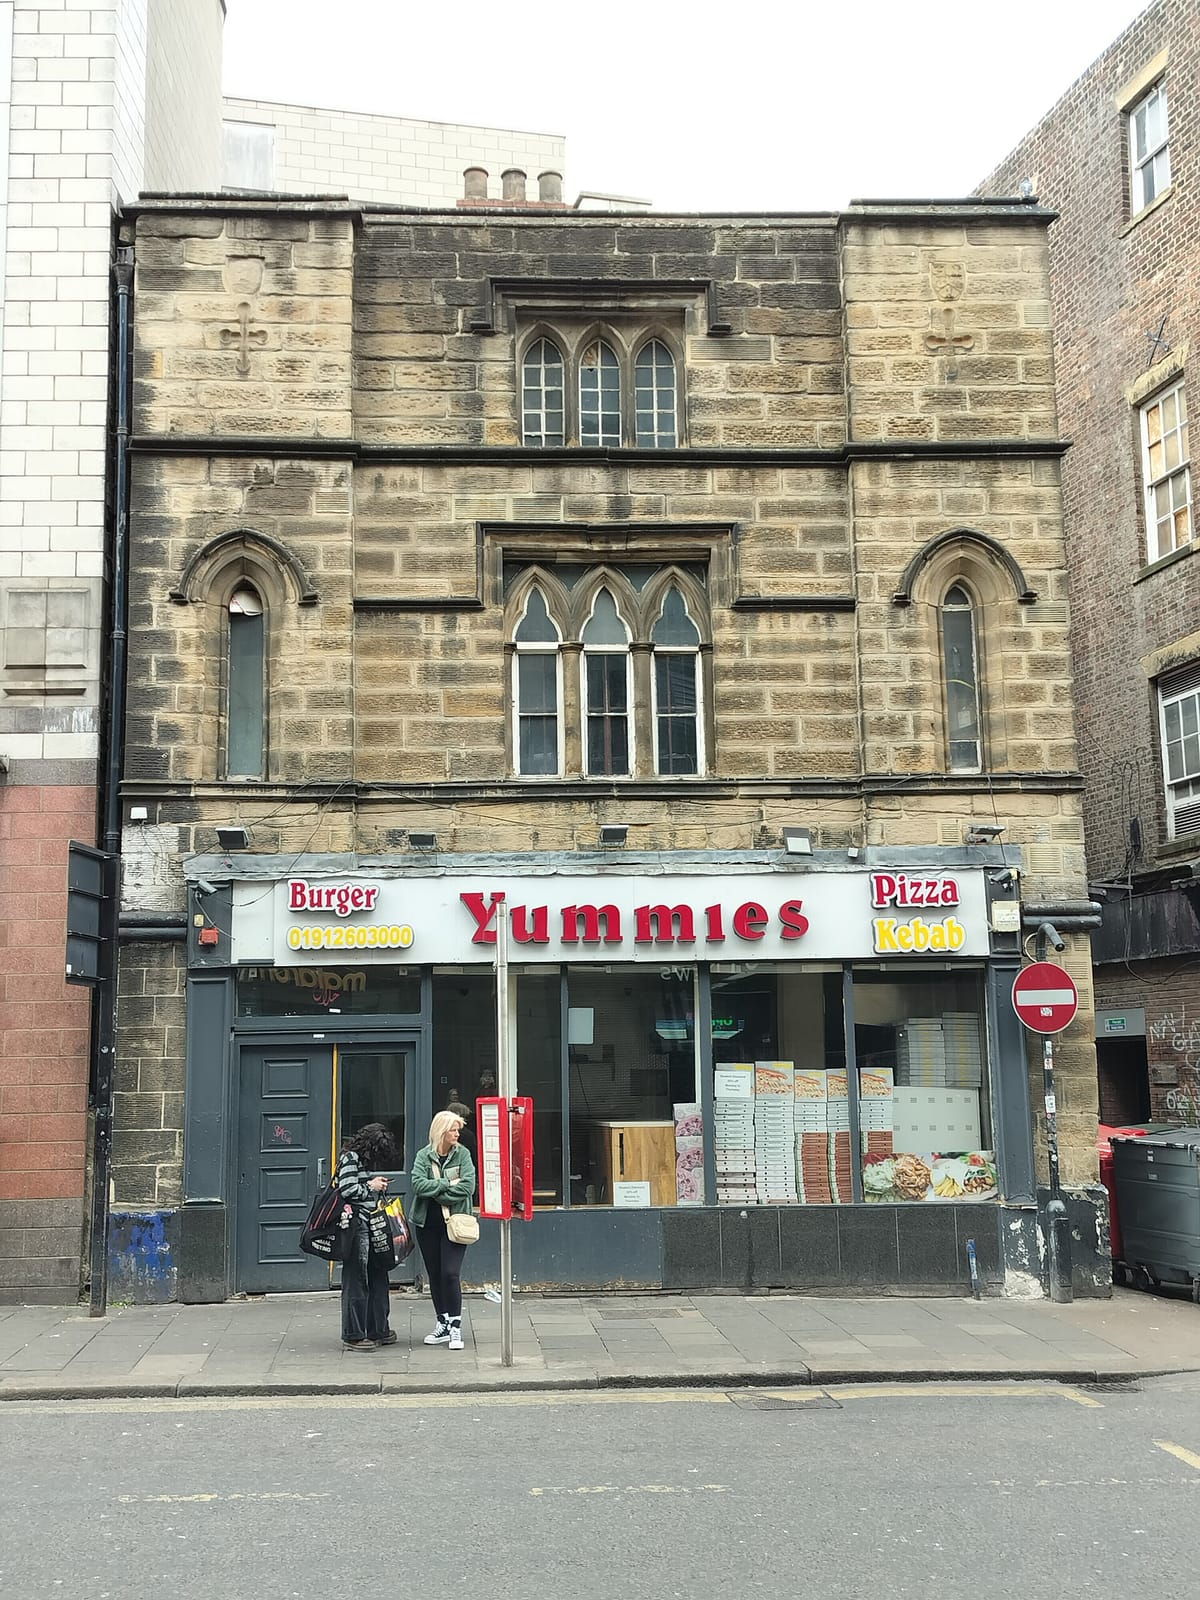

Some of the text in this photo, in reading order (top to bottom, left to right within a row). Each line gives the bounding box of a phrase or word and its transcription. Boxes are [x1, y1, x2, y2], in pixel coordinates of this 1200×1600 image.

[290, 882, 377, 915] Burger
[873, 875, 959, 904] Pizza
[459, 891, 811, 944] Yummies
[289, 926, 412, 947] 01912603000
[876, 918, 964, 951] Kebab
